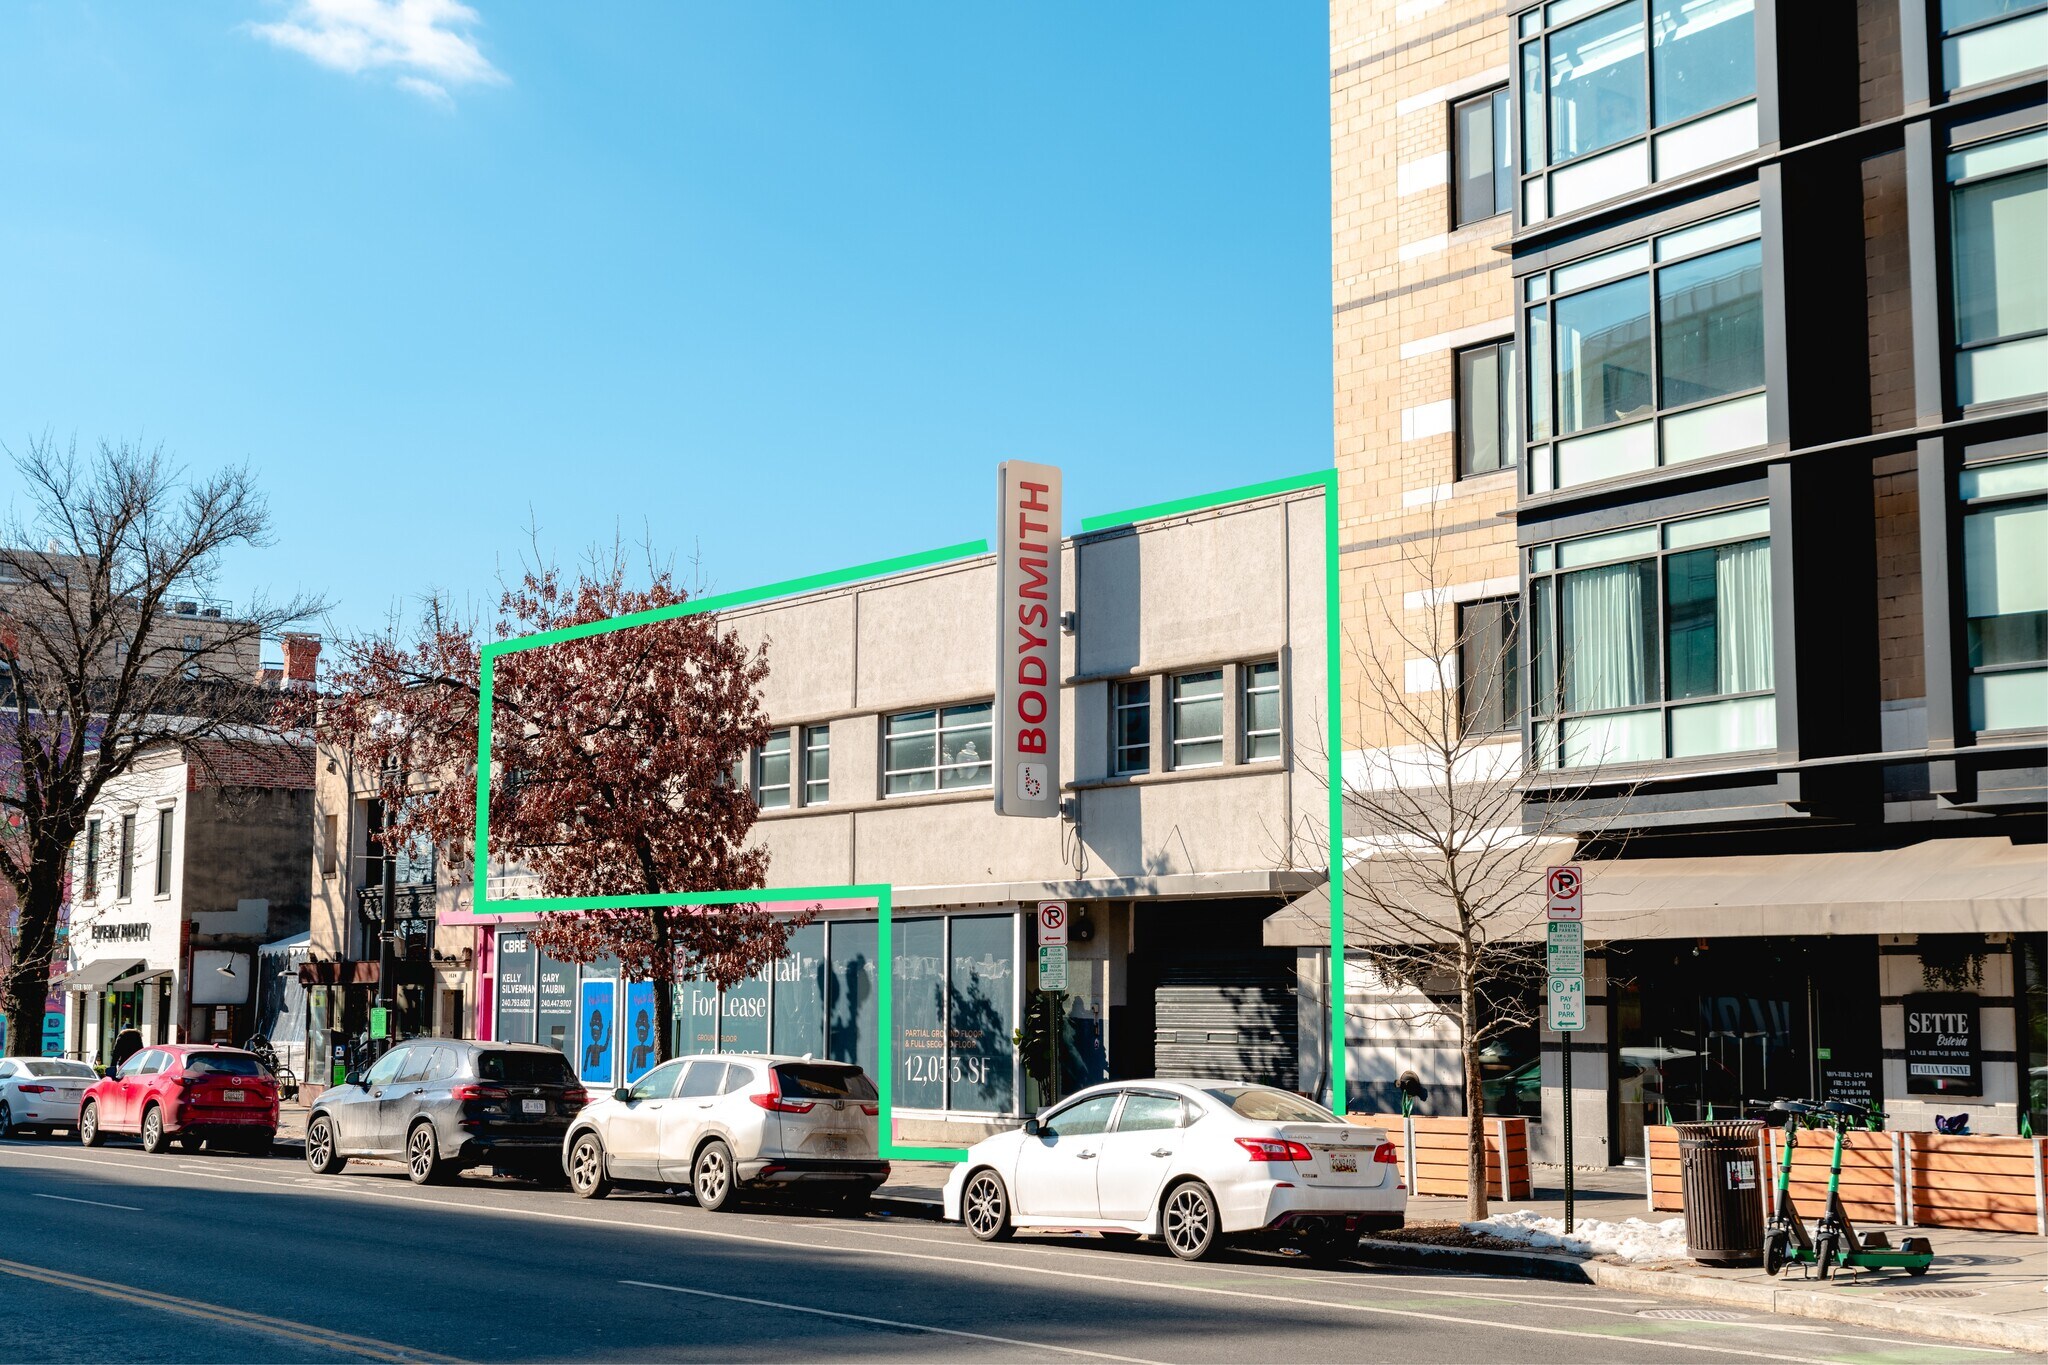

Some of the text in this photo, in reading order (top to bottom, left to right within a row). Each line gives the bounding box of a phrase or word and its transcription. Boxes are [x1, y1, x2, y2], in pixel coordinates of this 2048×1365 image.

[1017, 481, 1049, 755] BODYSMITH
[503, 940, 527, 953] CBRE
[502, 973, 522, 983] KELLY
[541, 973, 560, 983] GARY
[501, 984, 536, 994] SILVERMAN
[541, 984, 566, 994] TAUBIN
[692, 990, 717, 1017] For
[721, 990, 767, 1018] Lease
[1909, 1012, 1969, 1034] SETTE
[697, 1033, 716, 1041] GROUN
[905, 1029, 984, 1038] PARTIAL GROND FLOOR
[904, 1040, 910, 1048] &
[910, 1040, 925, 1048] FULL
[955, 1040, 977, 1048] FLOOR
[1936, 1034, 1968, 1047] Osteria
[968, 1056, 991, 1084] SF
[1912, 1064, 1969, 1075] ITALIAN CUISINE
